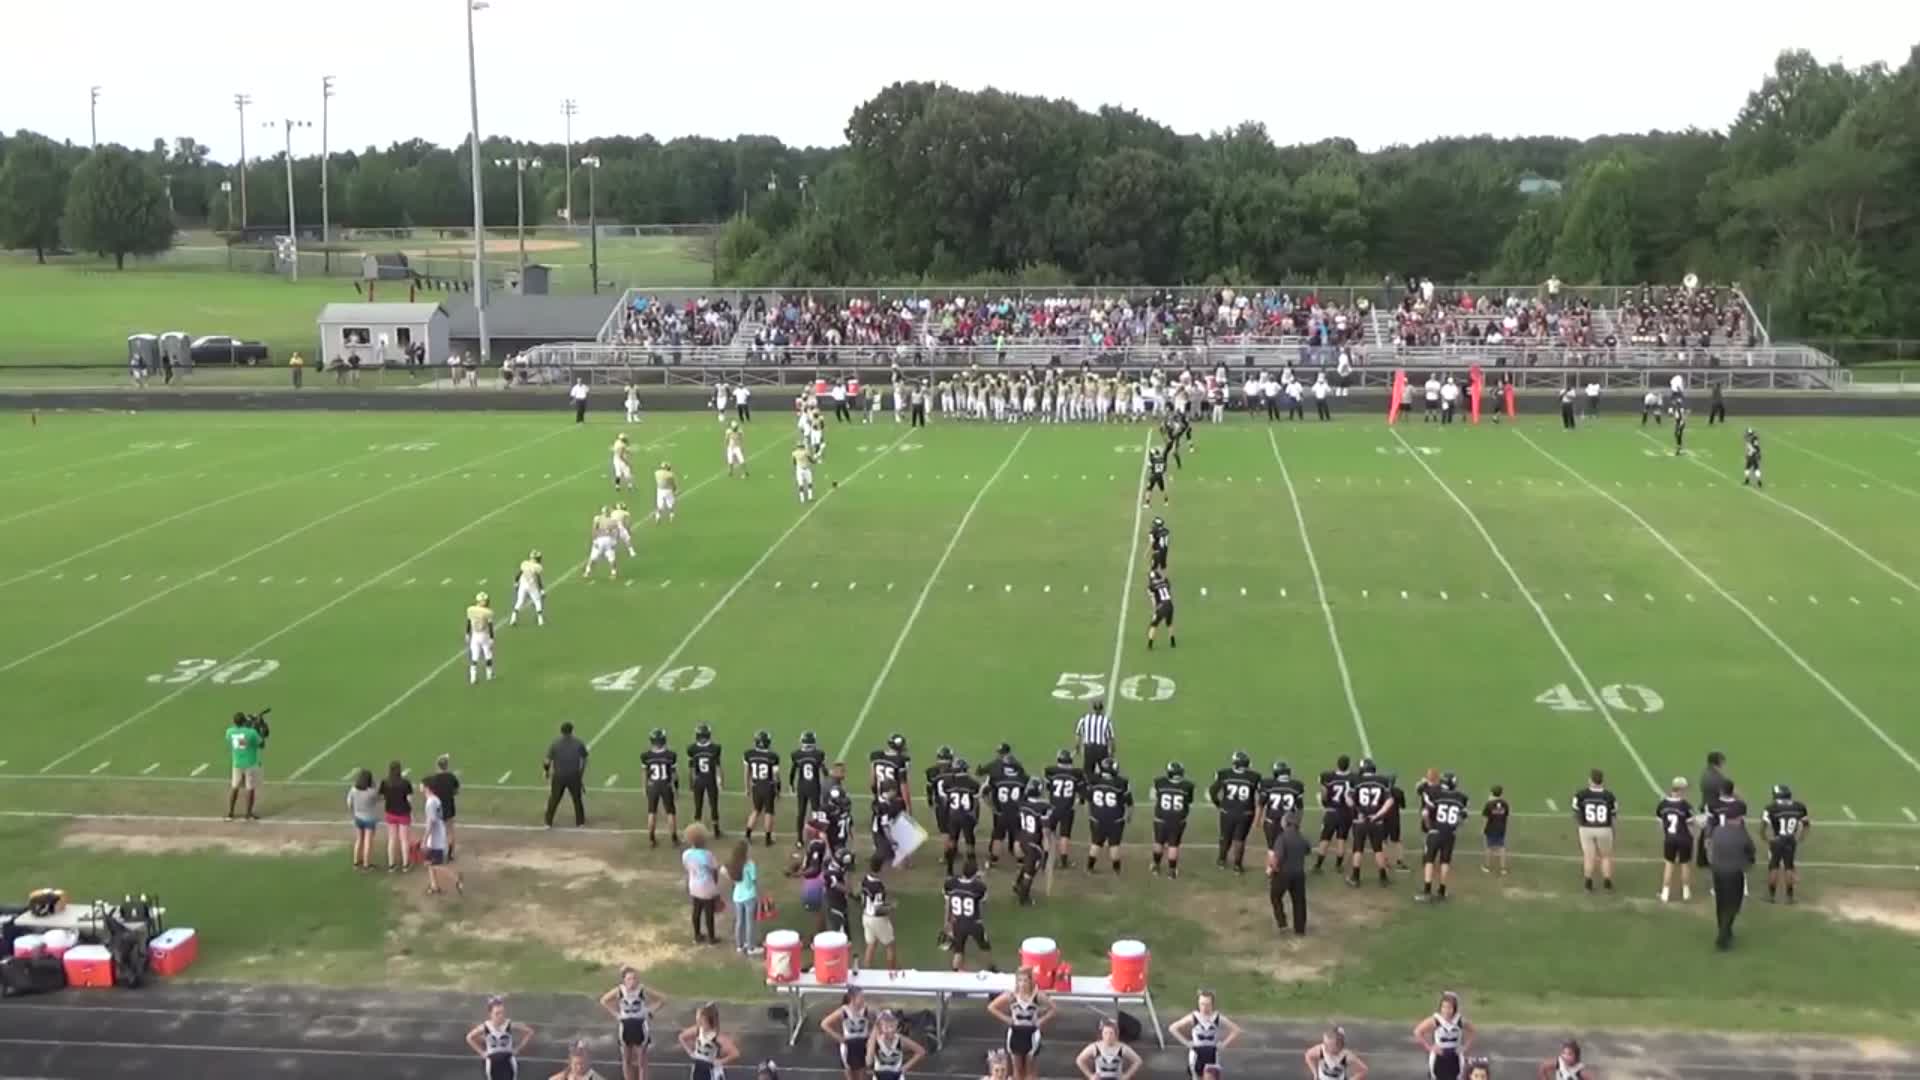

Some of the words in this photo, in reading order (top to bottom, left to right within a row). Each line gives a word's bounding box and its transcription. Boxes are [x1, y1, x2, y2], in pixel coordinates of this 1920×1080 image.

[590, 665, 717, 691] 40
[1051, 672, 1176, 701] 50
[1533, 683, 1665, 713] 40
[650, 763, 668, 780] 31
[751, 763, 769, 779] 12
[803, 763, 813, 780] 6
[1053, 780, 1074, 797] 72
[1359, 787, 1382, 806] 67
[950, 792, 971, 810] 34
[1092, 790, 1118, 807] 66
[1160, 794, 1184, 811] 65
[1270, 793, 1295, 810] 73
[1436, 803, 1459, 824] 56
[1585, 803, 1607, 822] 58
[1020, 812, 1036, 833] 19
[1667, 813, 1678, 834] 7
[950, 896, 975, 916] 99
